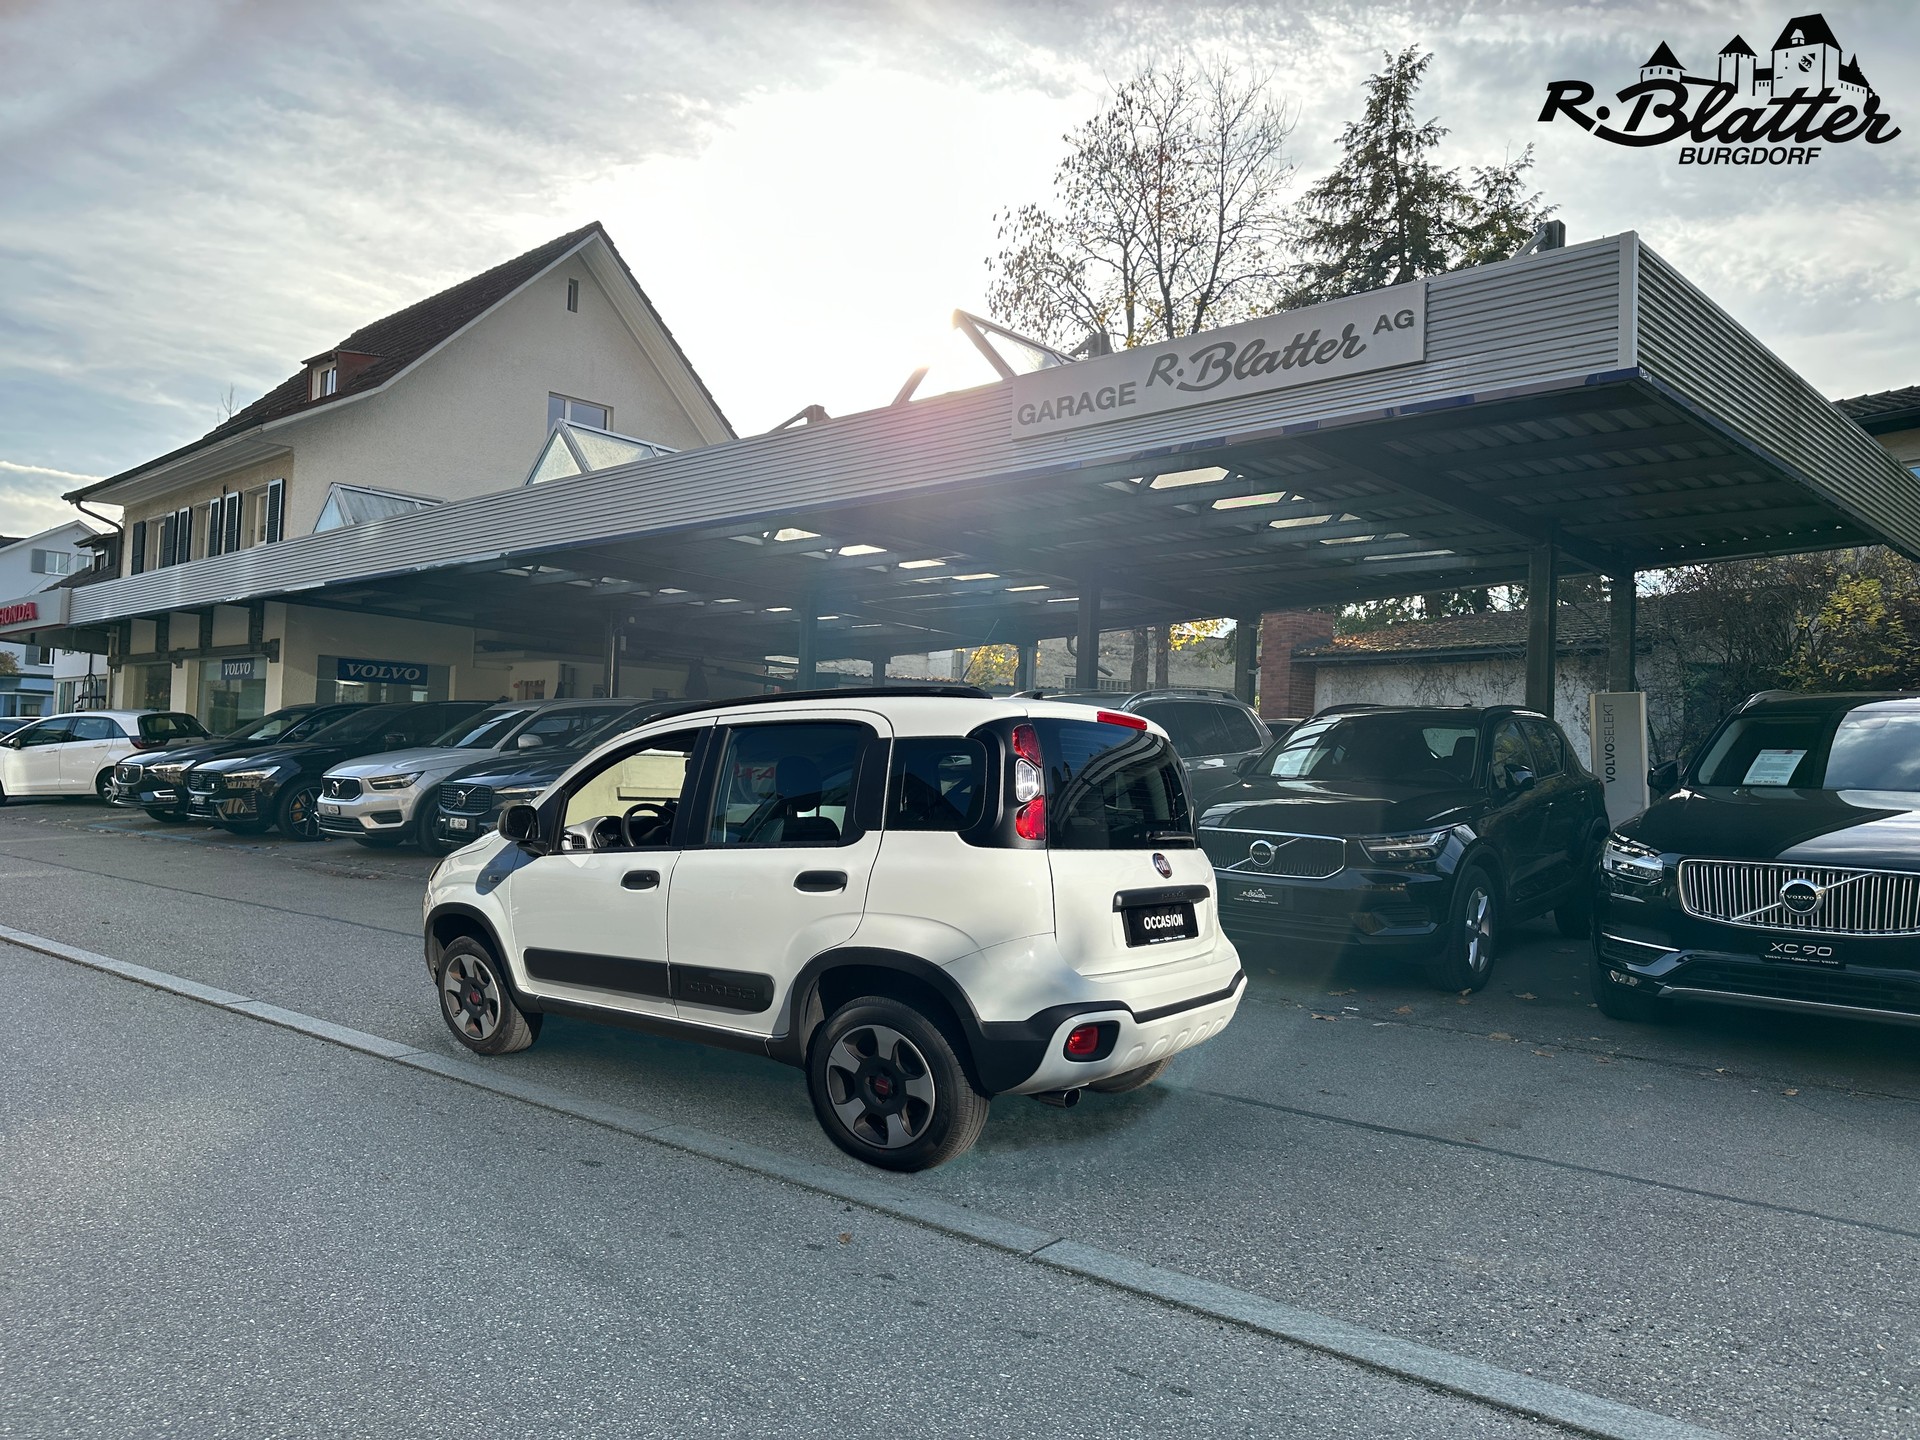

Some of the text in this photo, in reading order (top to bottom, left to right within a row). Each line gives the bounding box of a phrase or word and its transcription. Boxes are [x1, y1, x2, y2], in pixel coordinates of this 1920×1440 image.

[1017, 381, 1137, 425] GARAGE
[1373, 309, 1415, 336] AG
[224, 662, 251, 676] VOLVO
[346, 663, 421, 681] VOLVO
[1143, 913, 1184, 930] OCCASION
[1770, 942, 1833, 957] XC 90
